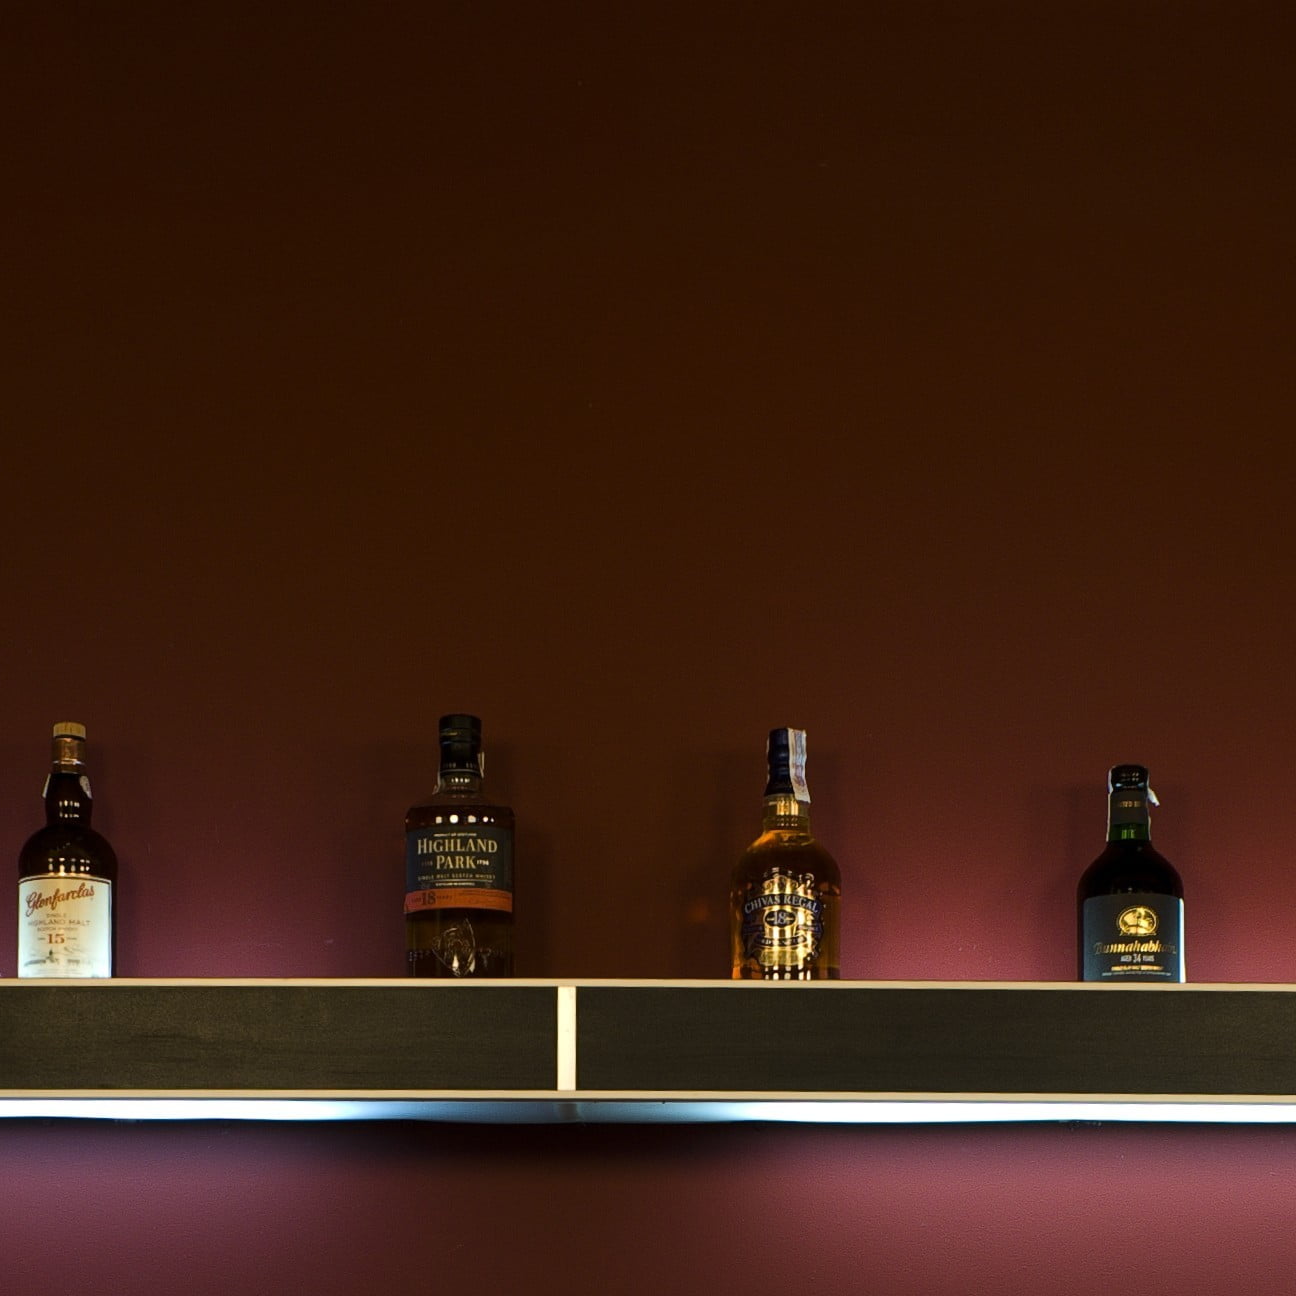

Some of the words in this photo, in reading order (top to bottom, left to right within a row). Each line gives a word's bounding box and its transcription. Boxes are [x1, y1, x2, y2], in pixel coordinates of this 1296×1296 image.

[417, 838, 498, 855] HIGHLAND
[436, 855, 477, 870] PARK
[25, 882, 95, 918] Glenfarclas
[744, 895, 781, 914] CHIVAS
[784, 895, 819, 913] REGAL
[773, 911, 787, 925] 18
[47, 933, 65, 944] 15
